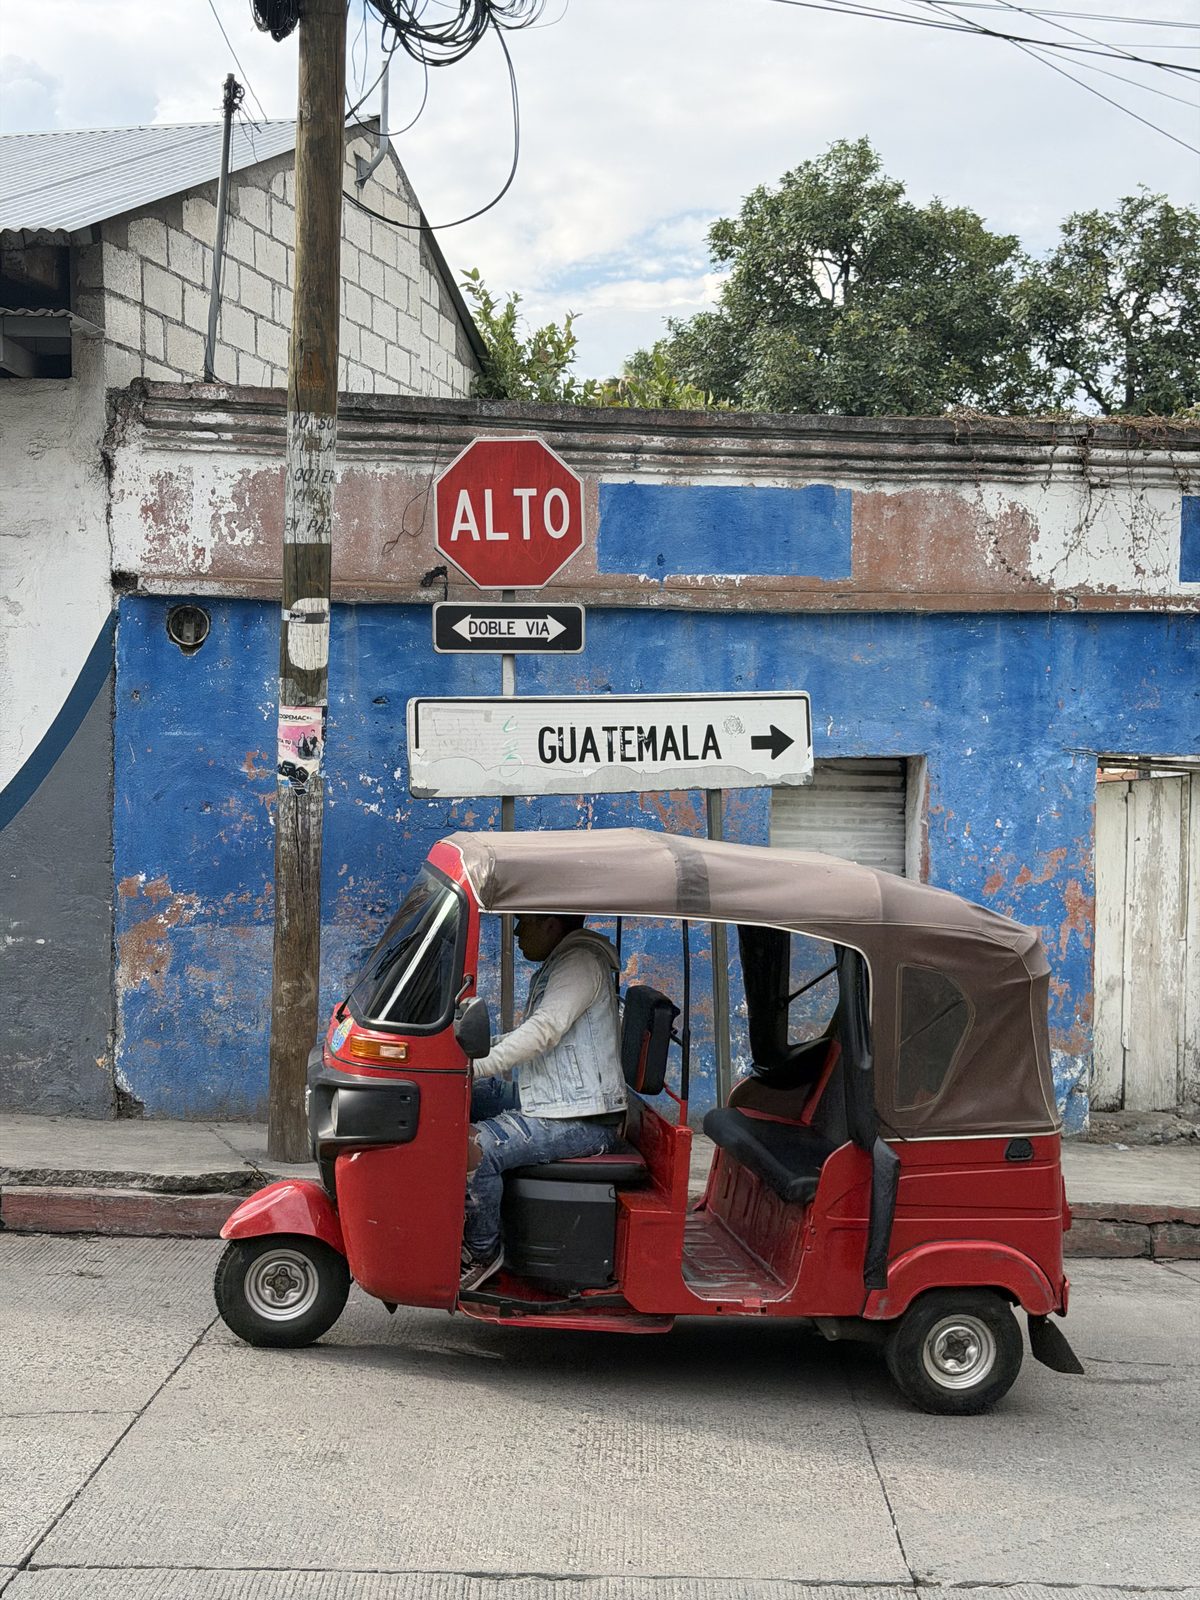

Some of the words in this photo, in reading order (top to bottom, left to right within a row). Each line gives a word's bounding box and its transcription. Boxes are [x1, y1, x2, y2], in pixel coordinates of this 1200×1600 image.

[318, 416, 335, 430] SO
[294, 467, 335, 484] QUIER
[450, 487, 570, 541] ALTO
[307, 518, 331, 534] PAZ
[468, 621, 515, 636] DOBLE
[526, 621, 550, 636] VIA
[538, 724, 722, 764] GUATEMALA
